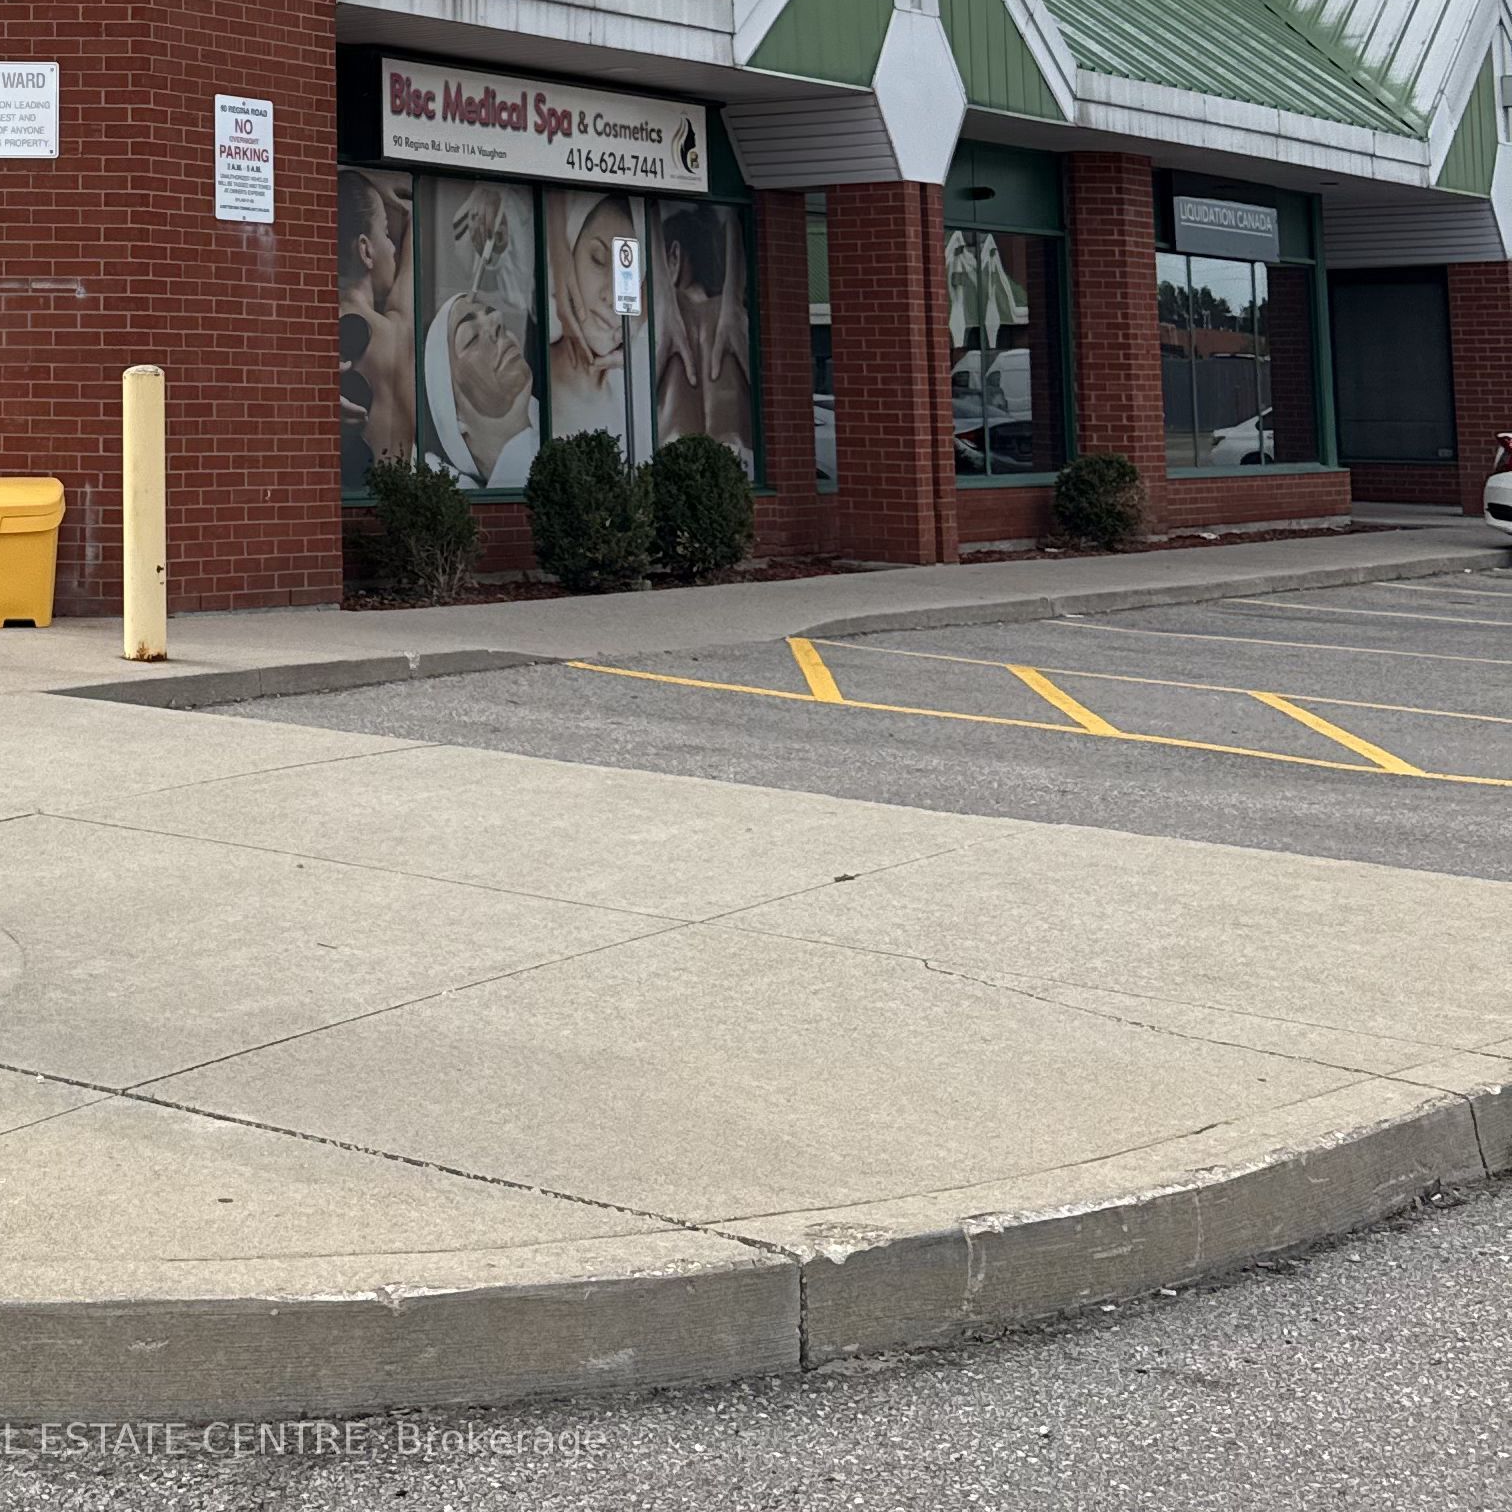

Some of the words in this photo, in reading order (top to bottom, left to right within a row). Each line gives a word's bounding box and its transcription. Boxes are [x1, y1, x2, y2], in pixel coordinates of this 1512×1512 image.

[14, 101, 51, 109] LEADING
[228, 105, 250, 115] REGINA
[251, 108, 268, 118] ROAD
[390, 72, 436, 121] Bisc
[441, 80, 528, 133] Medical
[533, 92, 573, 144] Spa
[577, 111, 590, 134] &
[593, 113, 663, 144] Cosmetics
[18, 113, 36, 122] AND
[234, 117, 253, 135] NO
[10, 126, 45, 135] ANYONE
[219, 144, 269, 163] PARKING
[393, 135, 402, 147] 90
[477, 145, 507, 160] Vaughan
[566, 148, 665, 180] 416-624-7441
[1179, 202, 1236, 227] LIQUIDATION
[1236, 211, 1273, 232] CANADA
